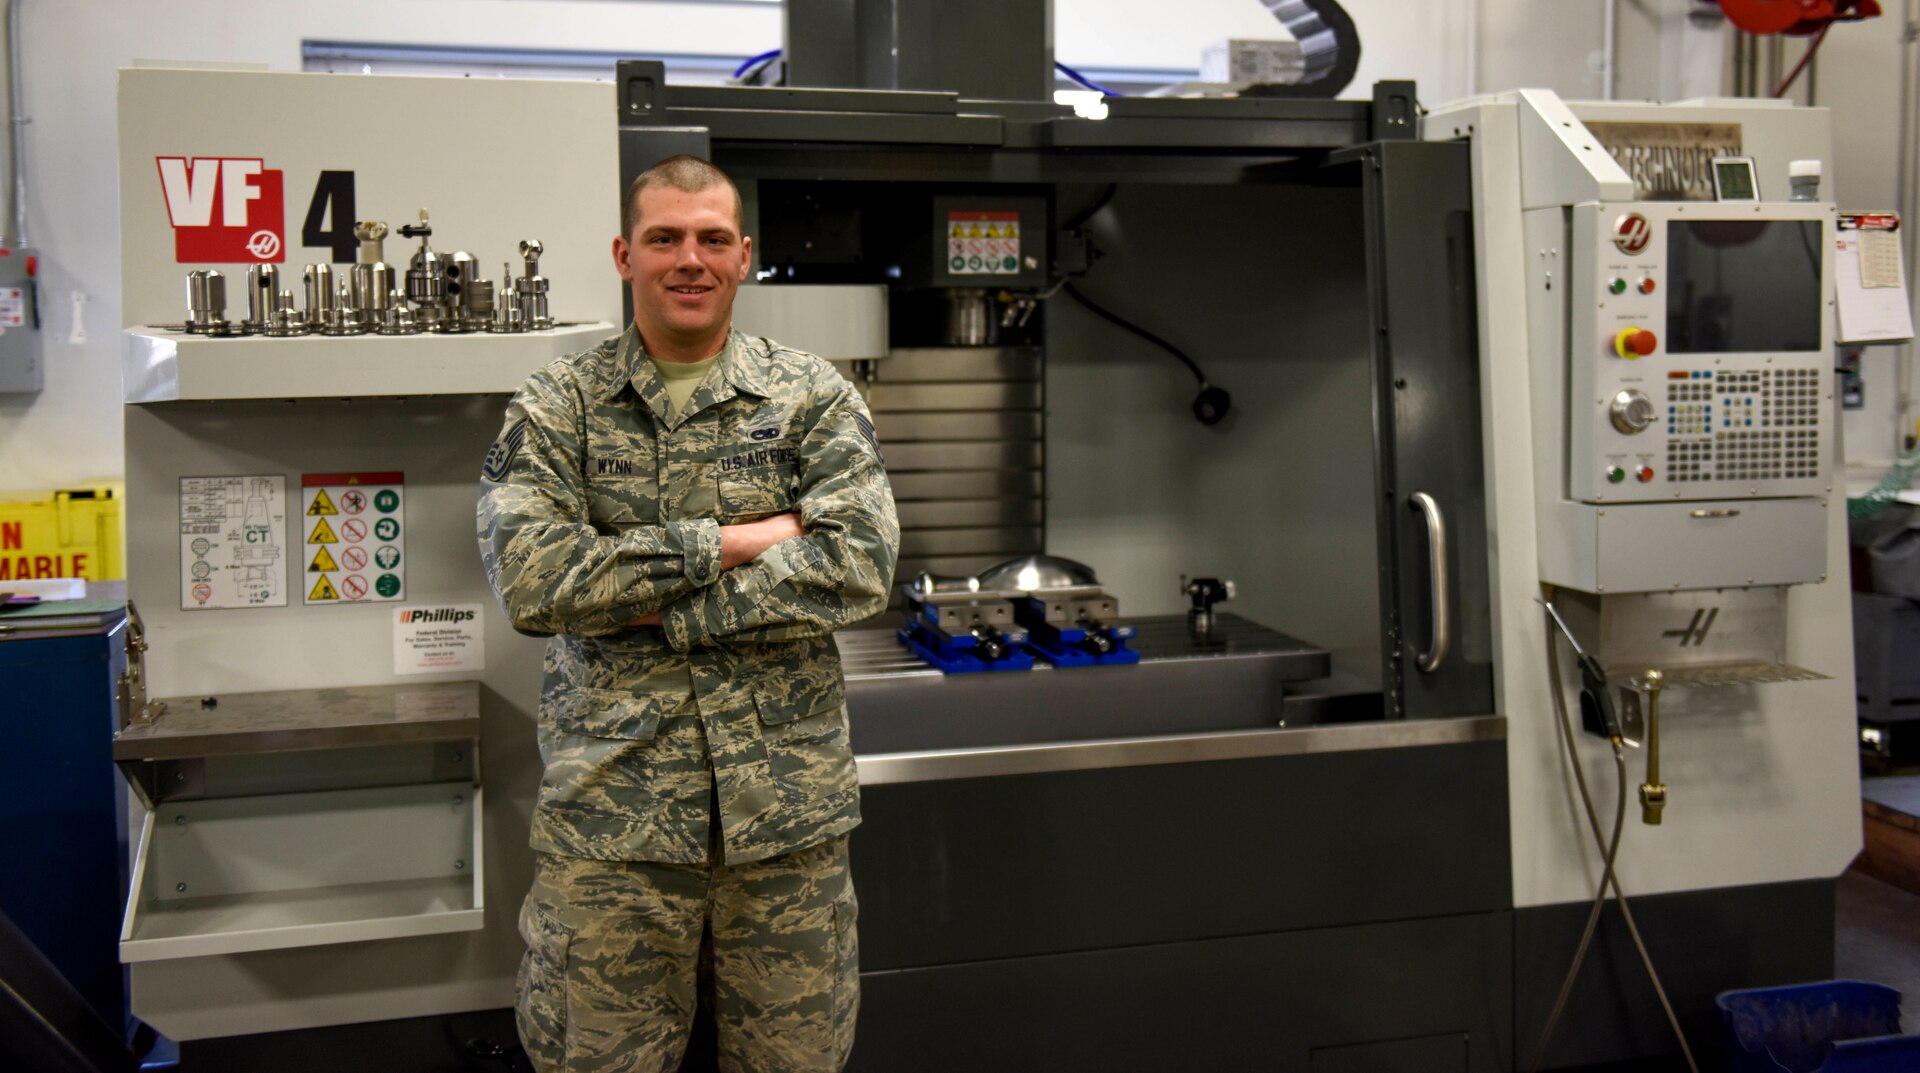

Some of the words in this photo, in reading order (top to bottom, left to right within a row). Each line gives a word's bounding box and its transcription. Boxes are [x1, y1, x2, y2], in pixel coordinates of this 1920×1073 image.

[156, 157, 263, 228] VF
[302, 170, 360, 264] 4
[597, 458, 632, 475] WYNN
[721, 455, 746, 472] U.S.
[747, 450, 769, 467] AIR
[246, 530, 269, 543] CT
[411, 608, 475, 624] Phillips
